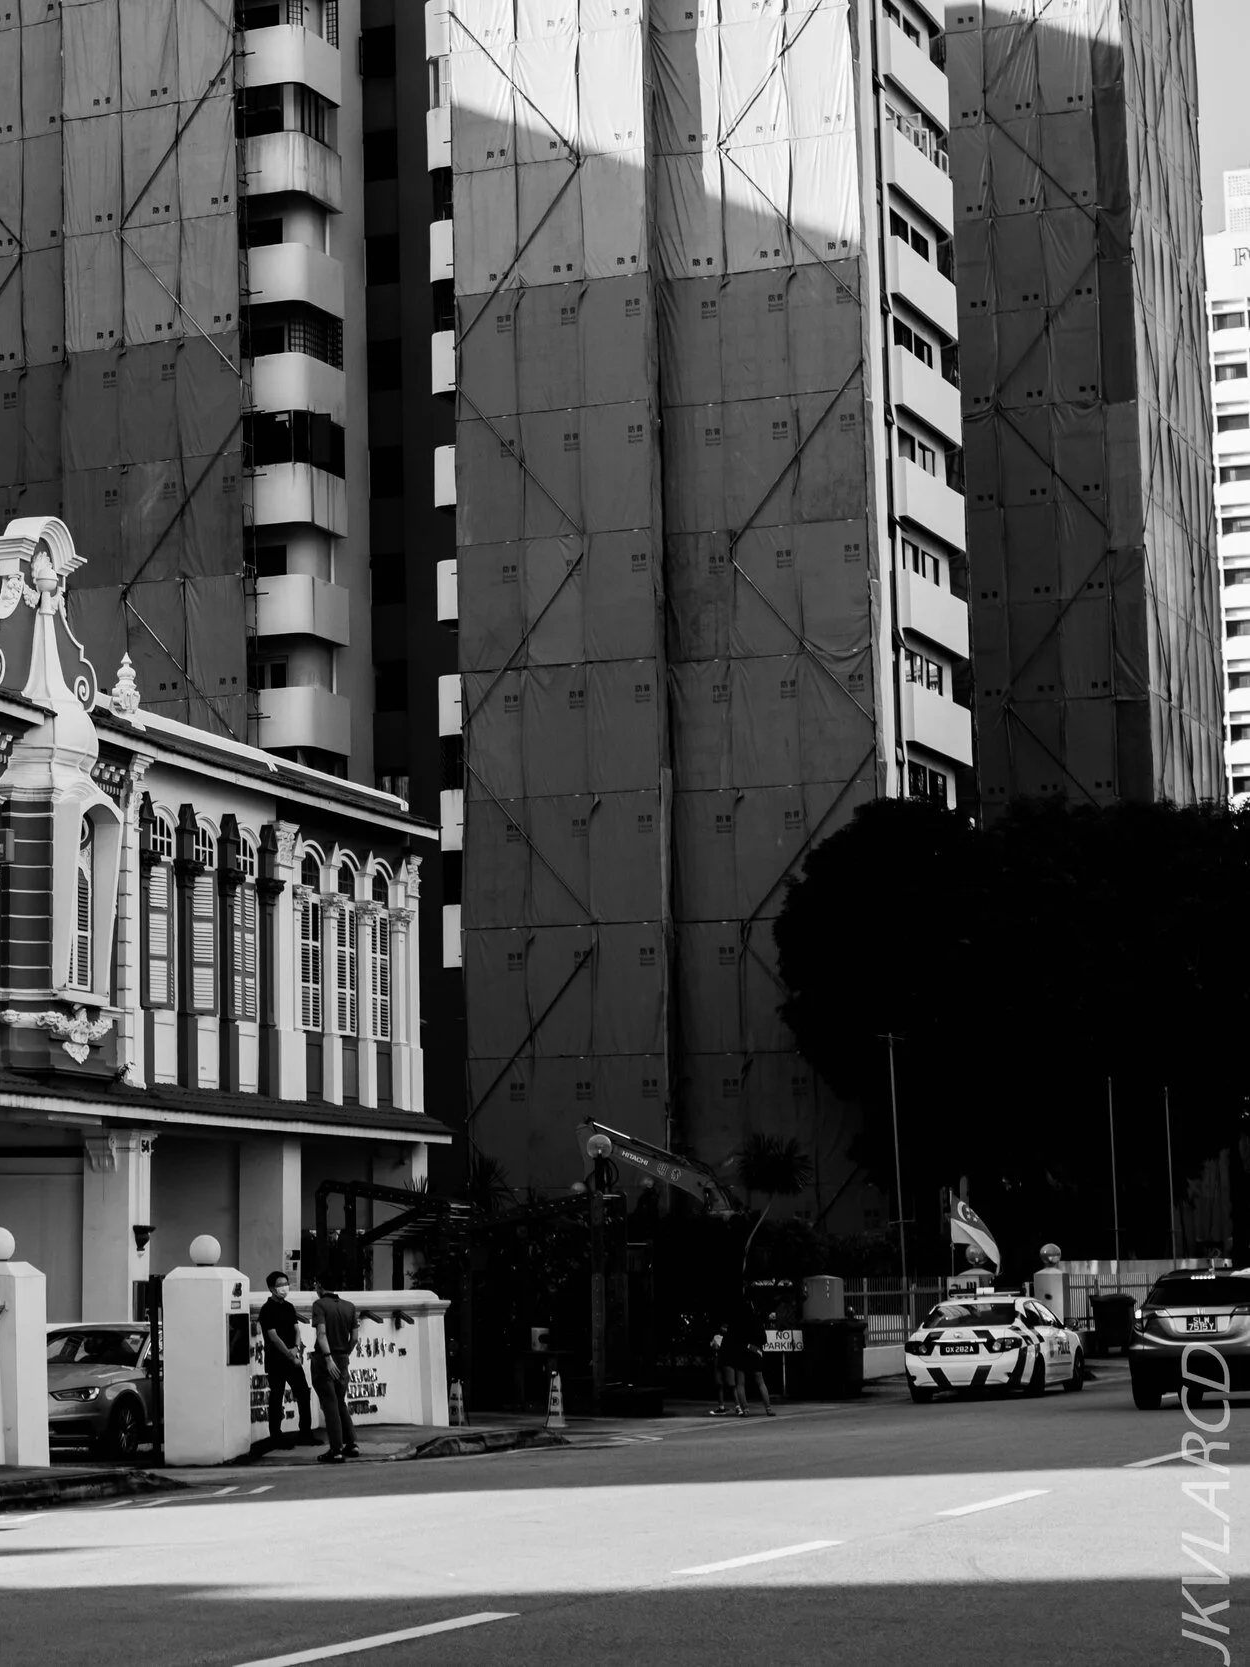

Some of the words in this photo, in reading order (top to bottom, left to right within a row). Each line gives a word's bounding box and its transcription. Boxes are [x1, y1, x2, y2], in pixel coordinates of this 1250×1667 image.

[622, 1150, 649, 1166] HITACHI
[776, 1331, 790, 1340] NO
[763, 1341, 803, 1350] PARKING
